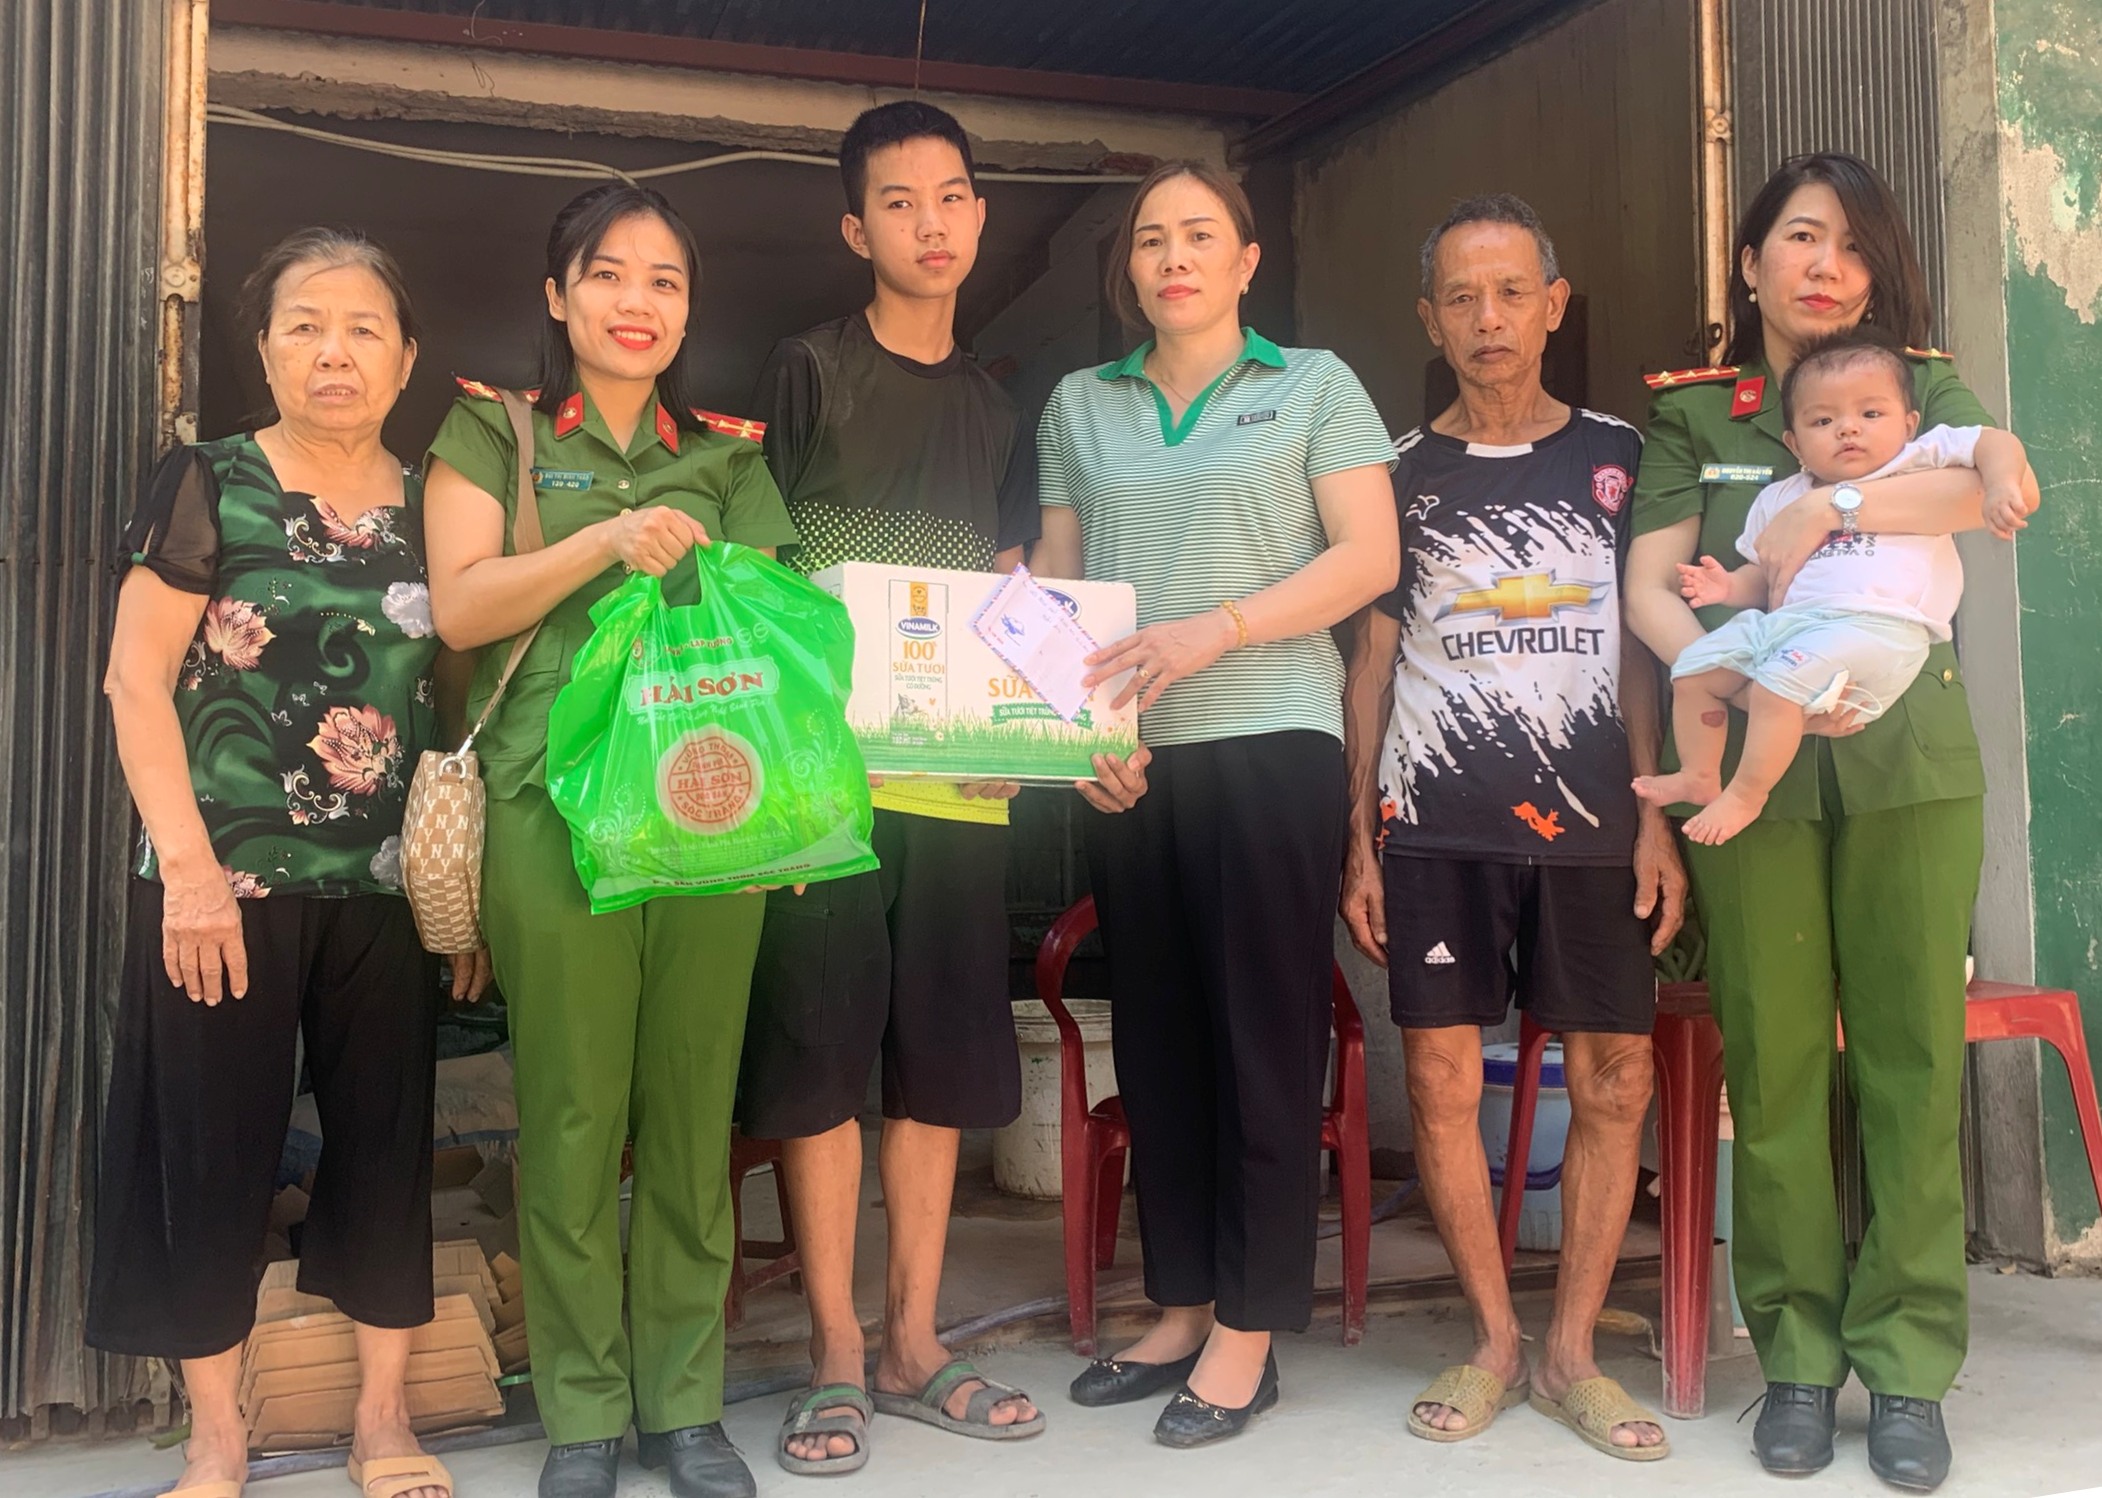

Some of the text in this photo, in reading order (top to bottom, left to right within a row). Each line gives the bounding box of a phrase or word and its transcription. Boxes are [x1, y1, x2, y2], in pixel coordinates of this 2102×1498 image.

[901, 620, 939, 632] VINAMILK
[1441, 625, 1605, 661] CHEVROLET
[697, 671, 764, 697] SƠN
[988, 675, 1033, 699] SỮA
